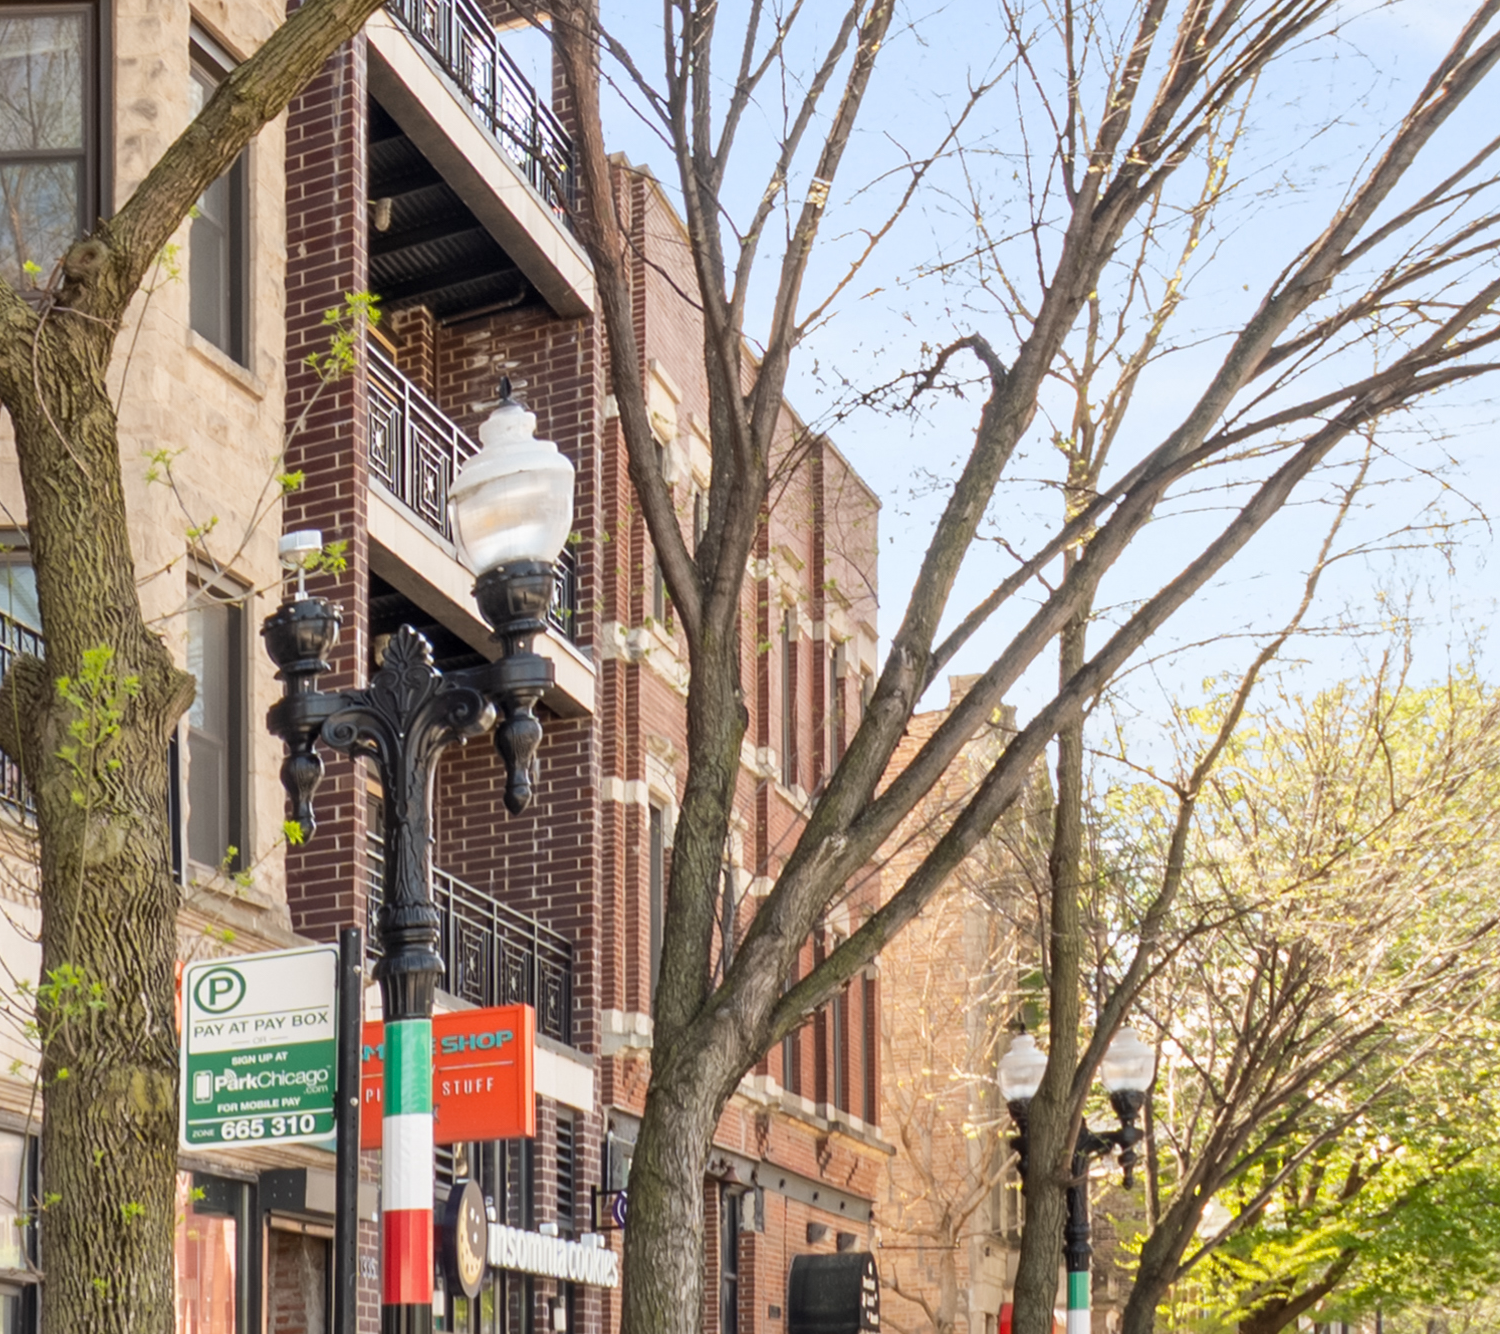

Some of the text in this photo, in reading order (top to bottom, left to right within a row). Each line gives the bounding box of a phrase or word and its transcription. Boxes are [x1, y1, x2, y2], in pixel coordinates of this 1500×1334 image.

[208, 976, 234, 1007] P
[194, 1012, 328, 1038] PAY AT PAY BOX
[252, 1036, 267, 1045] OR
[441, 1030, 514, 1054] SHOP
[231, 1051, 288, 1066] SIGN UP AT
[215, 1068, 329, 1093] ParkChicago
[442, 1077, 494, 1096] STUFF
[217, 1096, 301, 1113] FOR MOBILE PAY
[192, 1114, 316, 1140] ZONE 665 310
[487, 1206, 619, 1288] insomnia cookies
